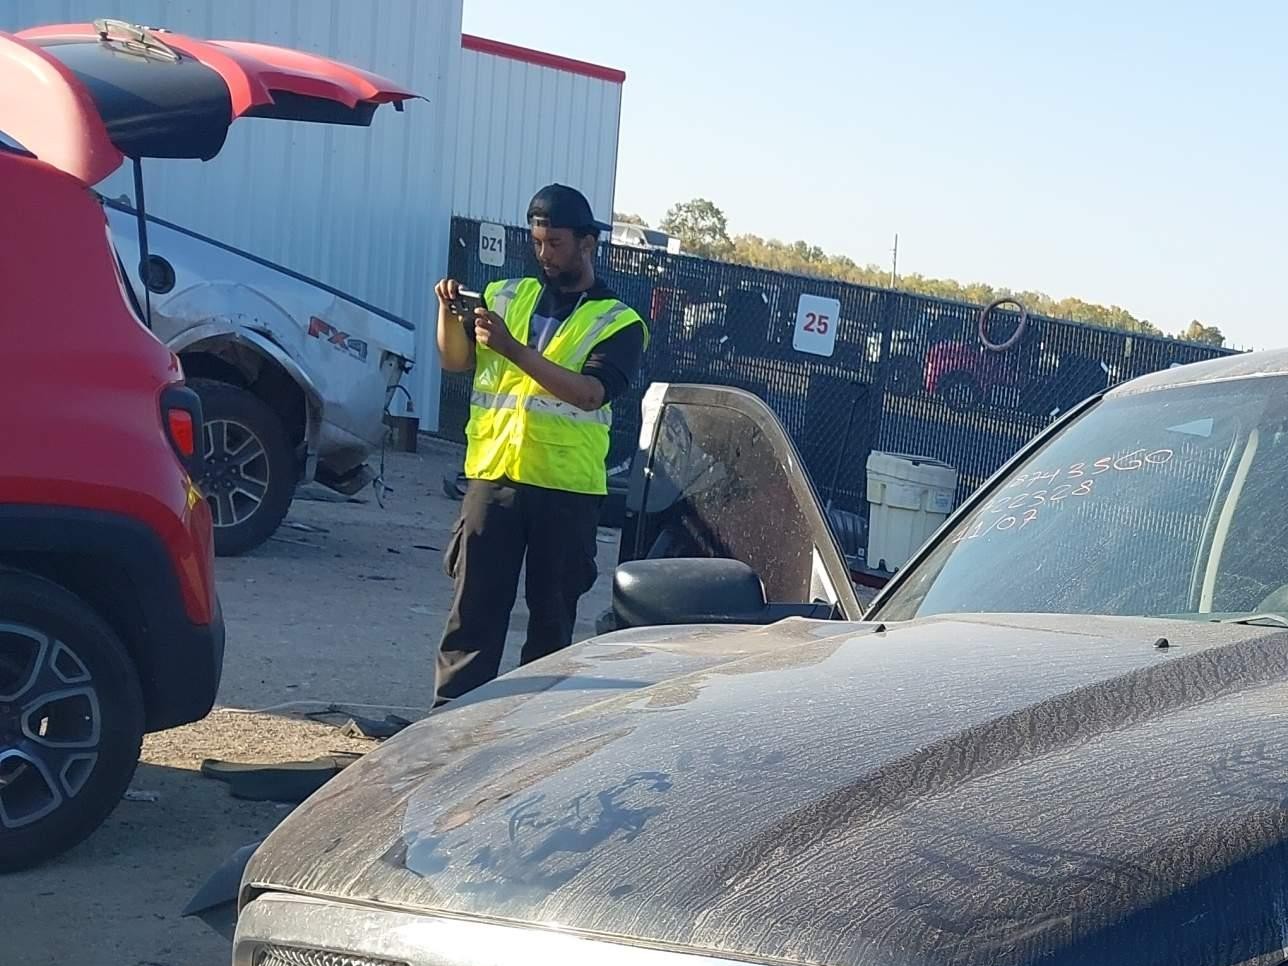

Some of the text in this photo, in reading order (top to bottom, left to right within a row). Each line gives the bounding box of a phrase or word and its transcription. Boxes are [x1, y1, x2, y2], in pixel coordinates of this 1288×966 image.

[481, 236, 503, 252] DZ1
[803, 312, 829, 335] 25
[308, 315, 368, 360] FX4
